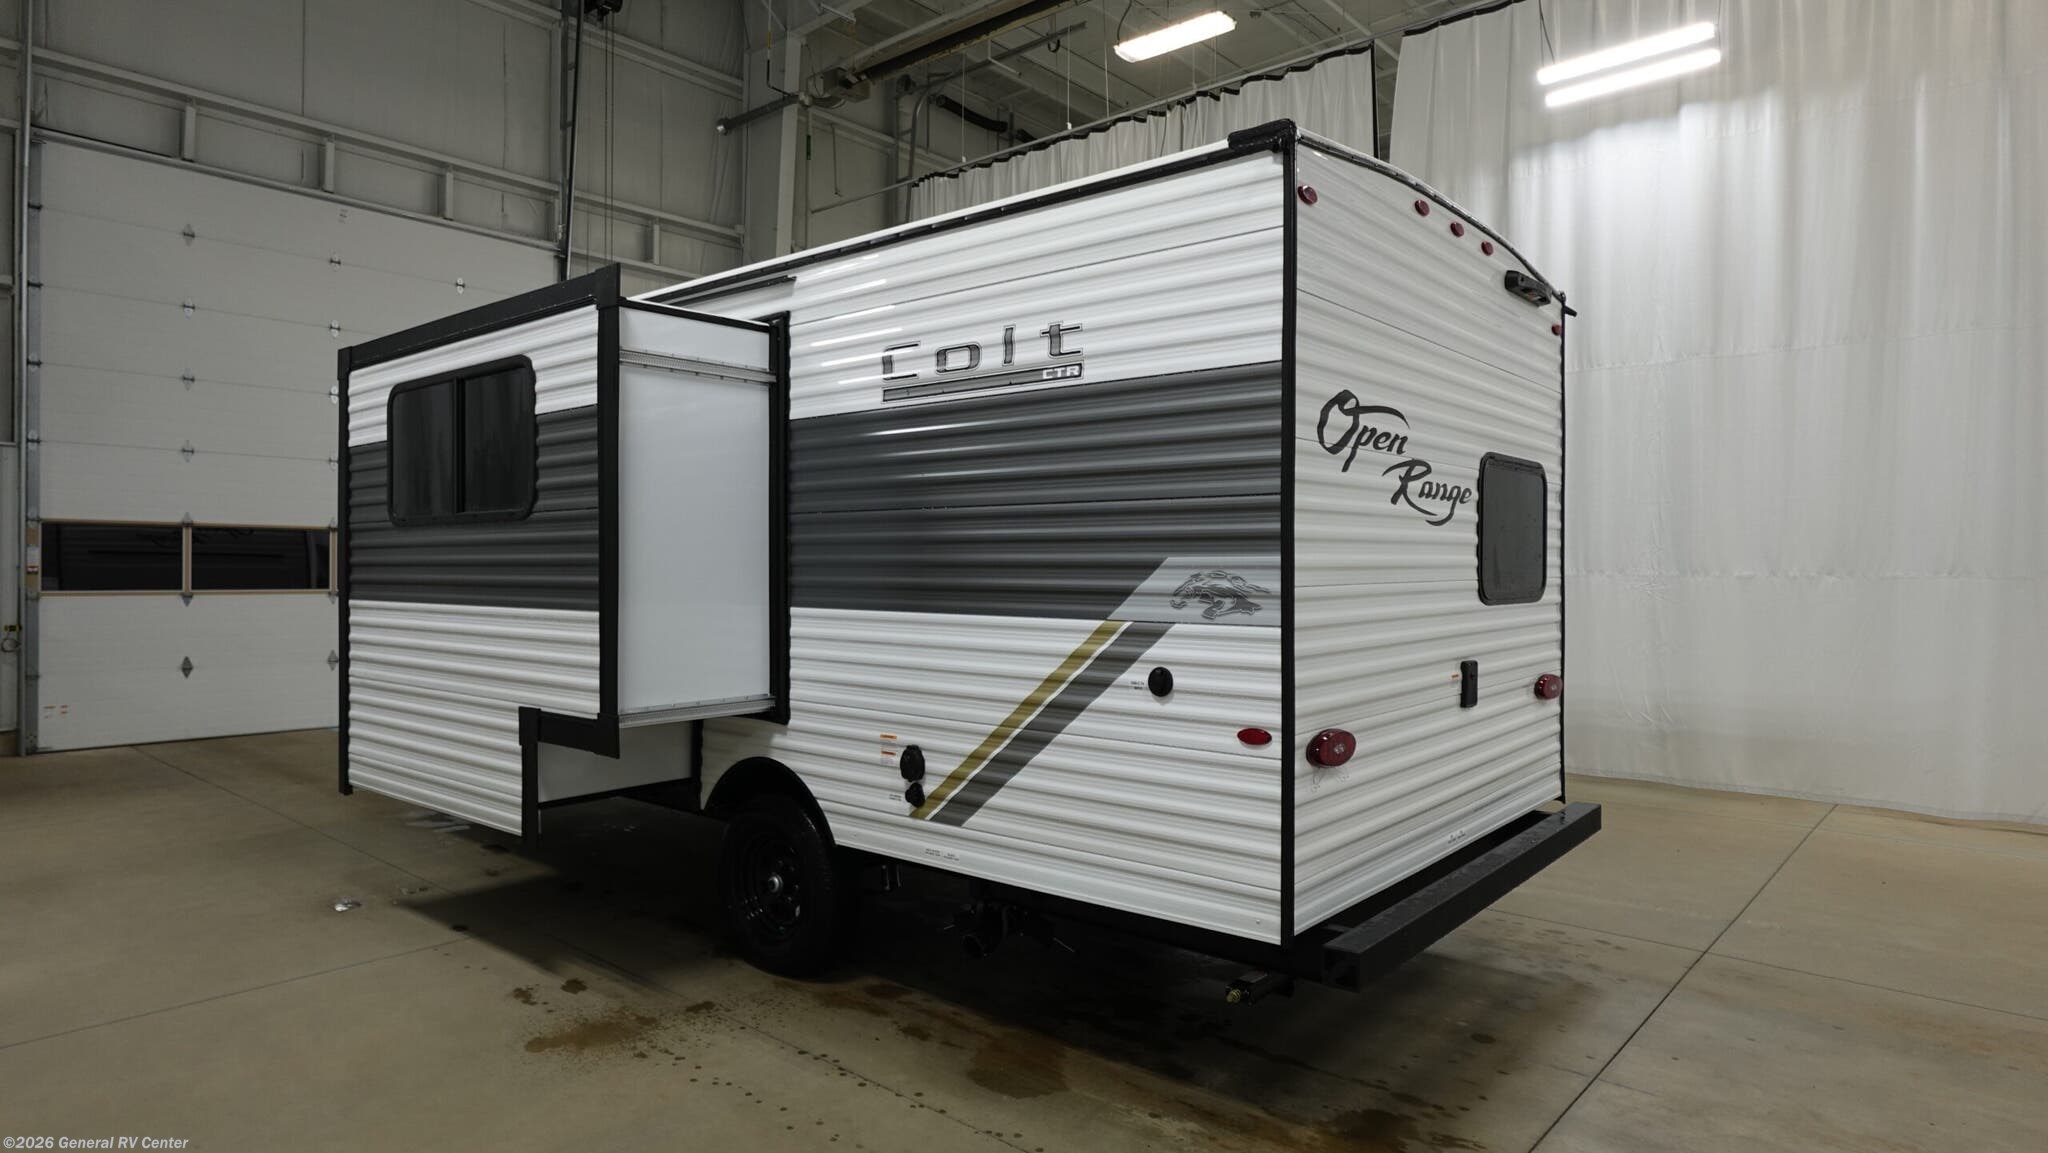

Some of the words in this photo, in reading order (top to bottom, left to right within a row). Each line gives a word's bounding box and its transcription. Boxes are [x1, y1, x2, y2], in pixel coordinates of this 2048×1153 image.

[882, 320, 1084, 382] Colt
[1042, 364, 1081, 379] CTR
[1317, 389, 1410, 472] Open
[1382, 459, 1473, 526] Range
